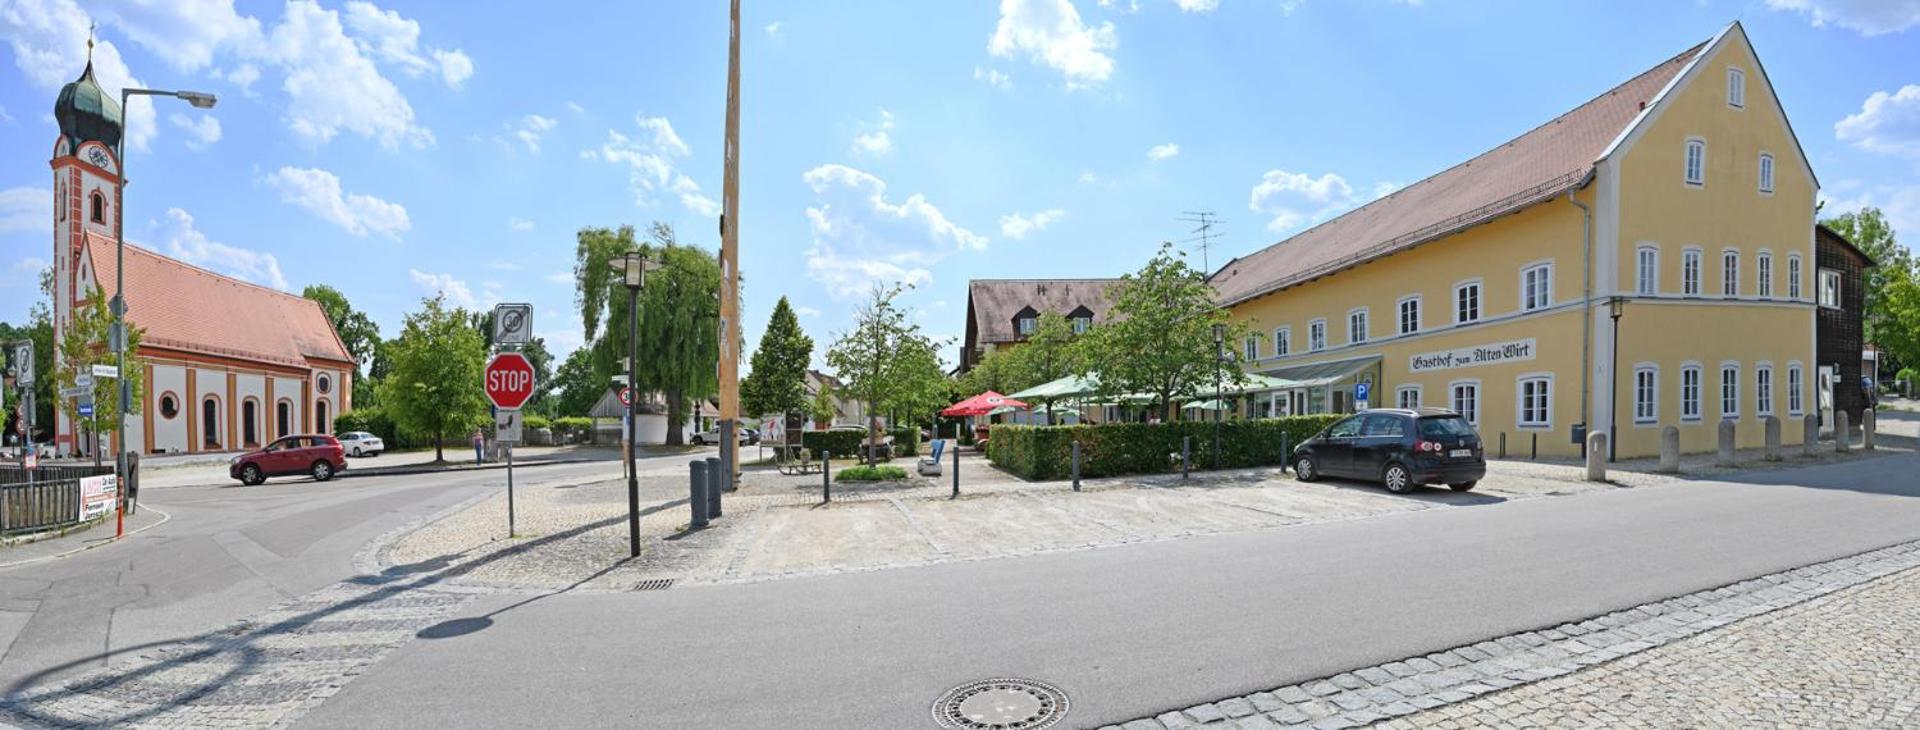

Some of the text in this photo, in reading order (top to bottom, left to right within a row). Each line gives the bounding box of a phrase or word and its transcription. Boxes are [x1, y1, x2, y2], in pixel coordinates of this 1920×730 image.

[1412, 343, 1530, 370] Gasthof zum Alten Wirt
[489, 369, 529, 392] STOP
[1357, 385, 1366, 398] P
